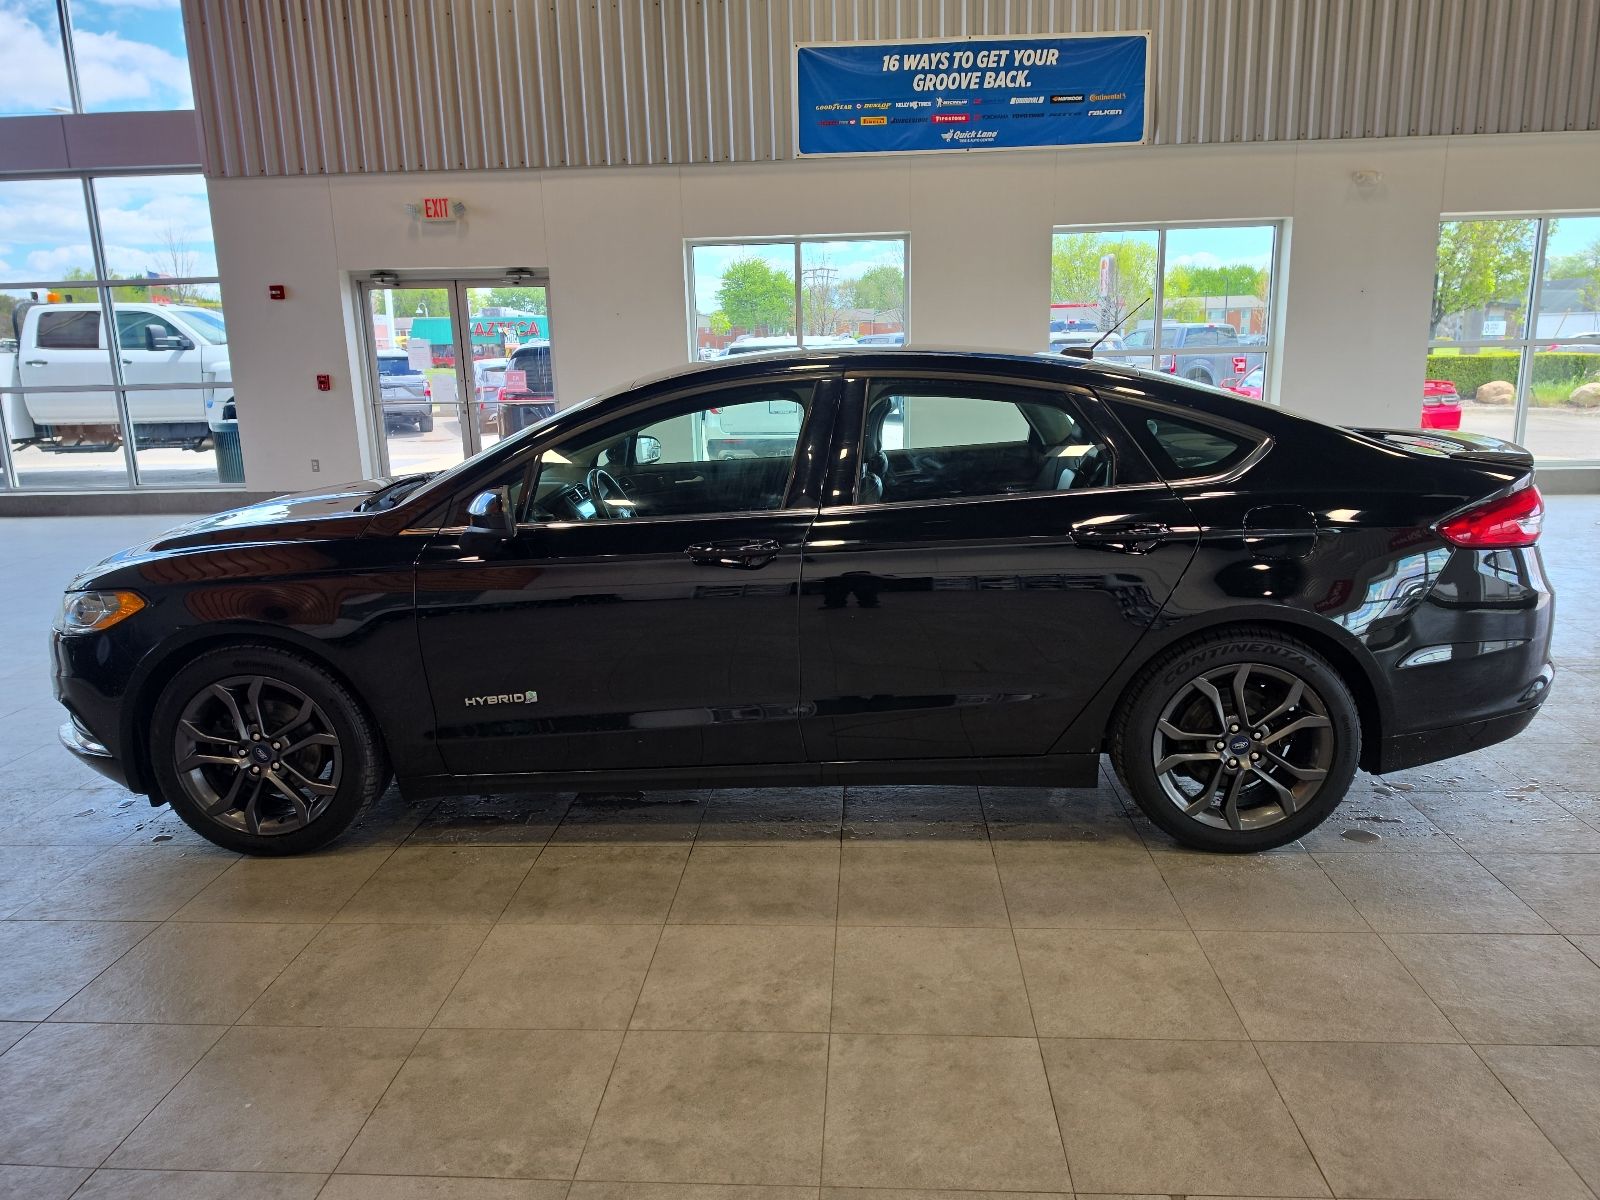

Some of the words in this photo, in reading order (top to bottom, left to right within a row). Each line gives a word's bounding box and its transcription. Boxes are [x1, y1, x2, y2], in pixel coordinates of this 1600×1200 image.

[883, 55, 900, 71] 16
[903, 52, 950, 70] WAYS
[953, 51, 974, 69] TO
[977, 50, 1009, 68] GET
[1013, 49, 1059, 66] YOUR
[913, 72, 981, 91] GROOVE
[983, 70, 1032, 88] BACK.
[1089, 93, 1122, 102] Continental
[954, 130, 976, 139] Quick
[977, 130, 997, 138] Lane
[424, 198, 448, 218] EXIT
[1163, 643, 1320, 686] CONTINENTAL
[464, 693, 525, 706] HYBRID
